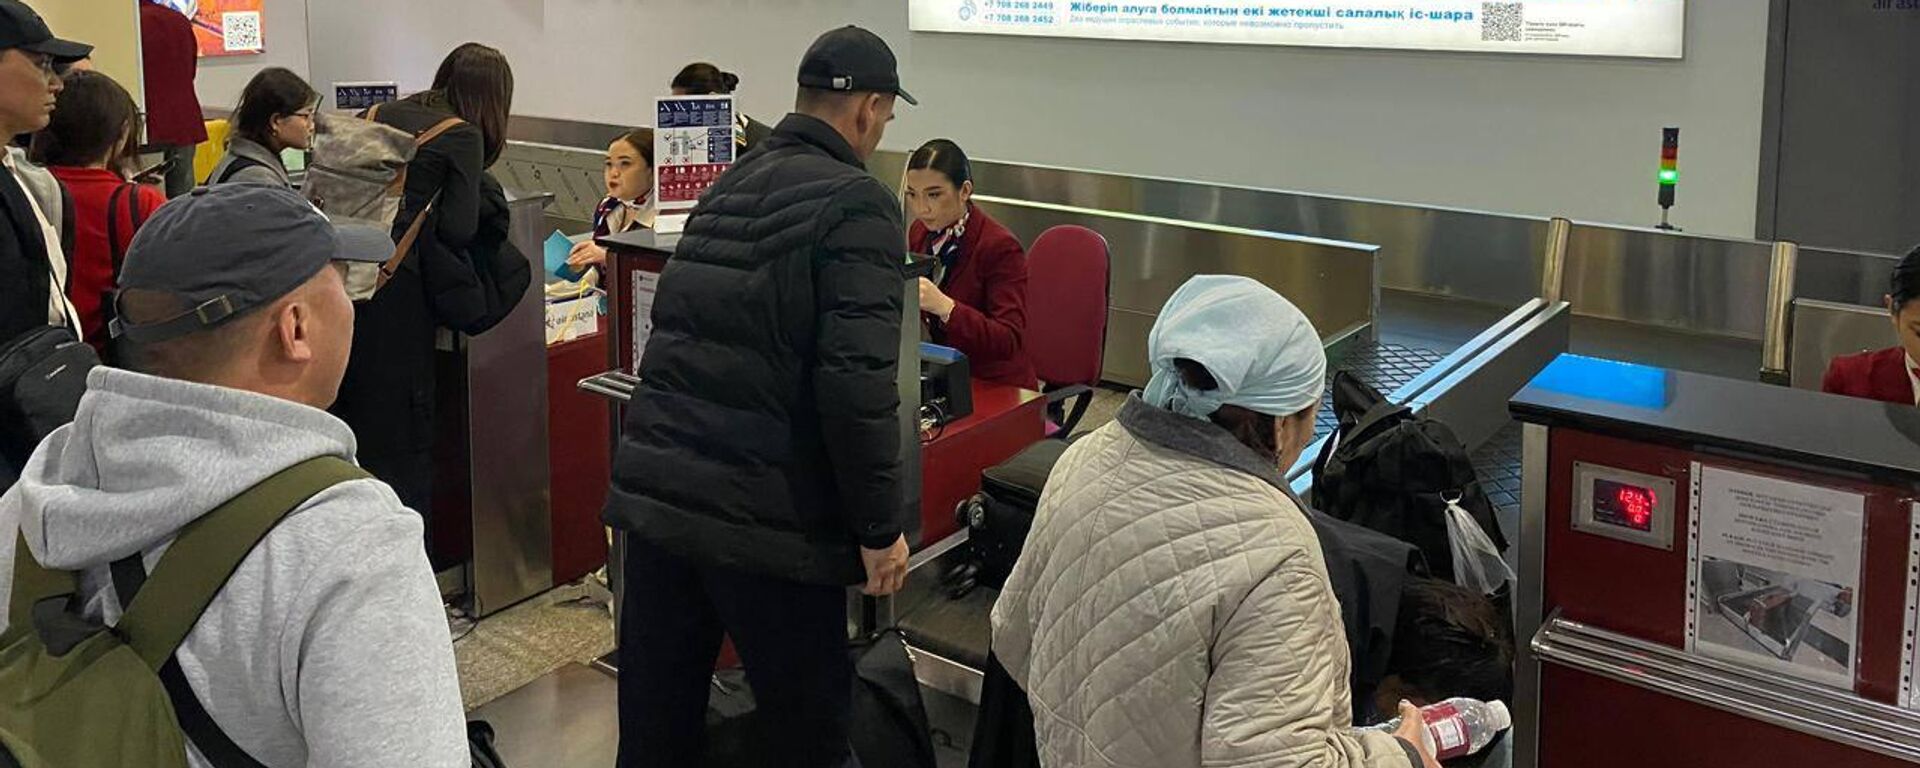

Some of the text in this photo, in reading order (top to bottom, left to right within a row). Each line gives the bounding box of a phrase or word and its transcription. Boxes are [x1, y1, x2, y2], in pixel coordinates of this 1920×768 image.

[1161, 4, 1239, 16] болмайтын
[1243, 6, 1264, 16] екі
[1268, 7, 1330, 18] жетекші
[1410, 8, 1474, 22] іс-шара
